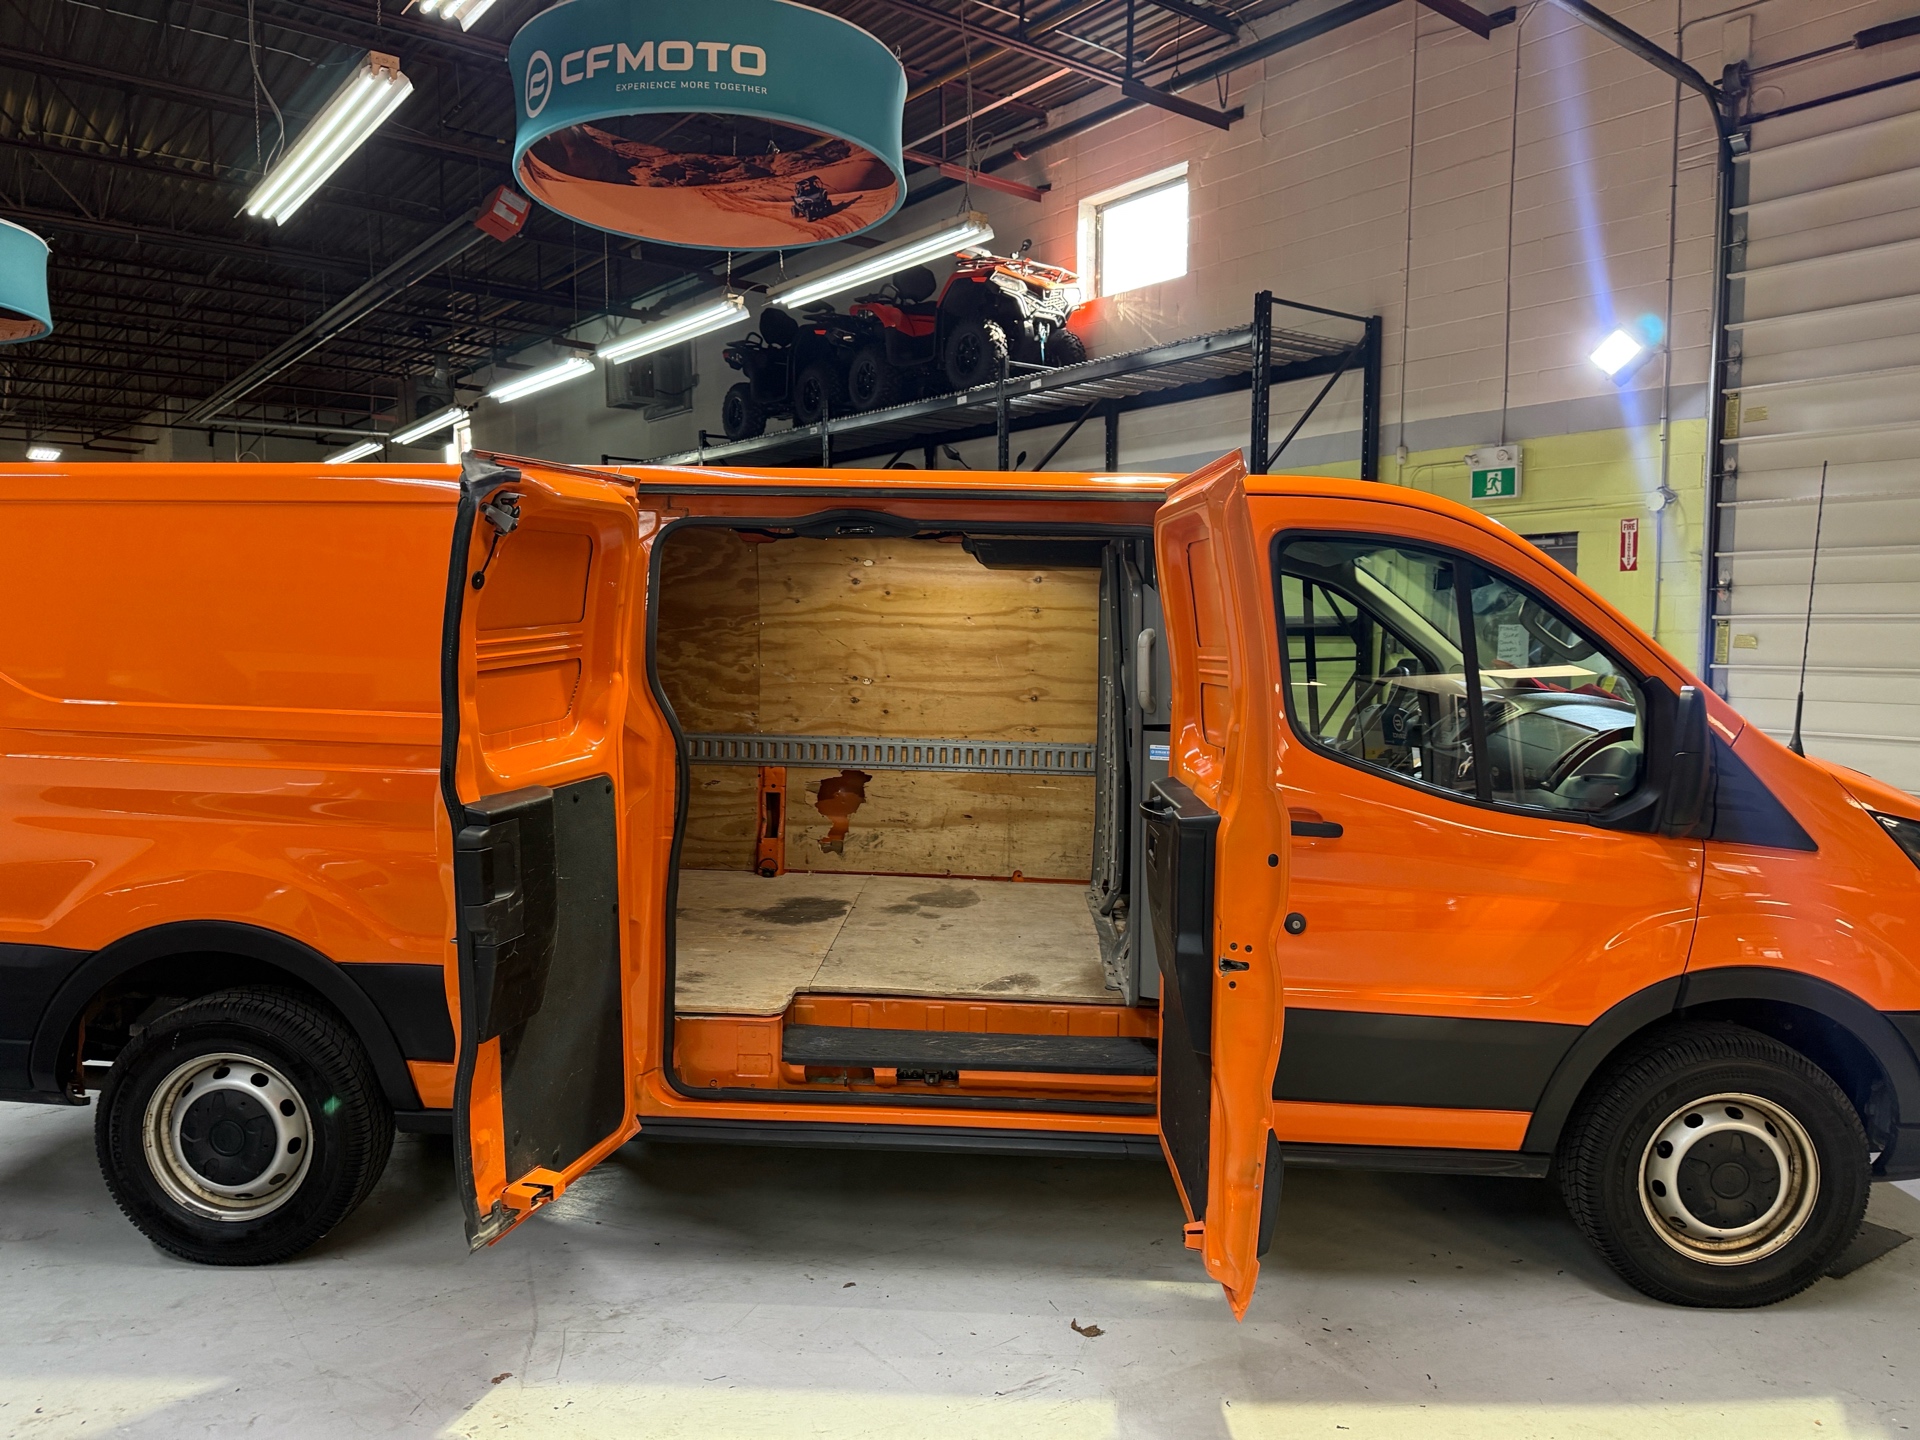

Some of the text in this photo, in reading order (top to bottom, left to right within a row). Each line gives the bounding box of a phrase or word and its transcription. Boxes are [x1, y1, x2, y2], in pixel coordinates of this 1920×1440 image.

[560, 41, 766, 85] CFMOTO
[615, 81, 768, 95] EXPERIENCE MORE TOGETHER
[1623, 523, 1636, 531] FIRE
